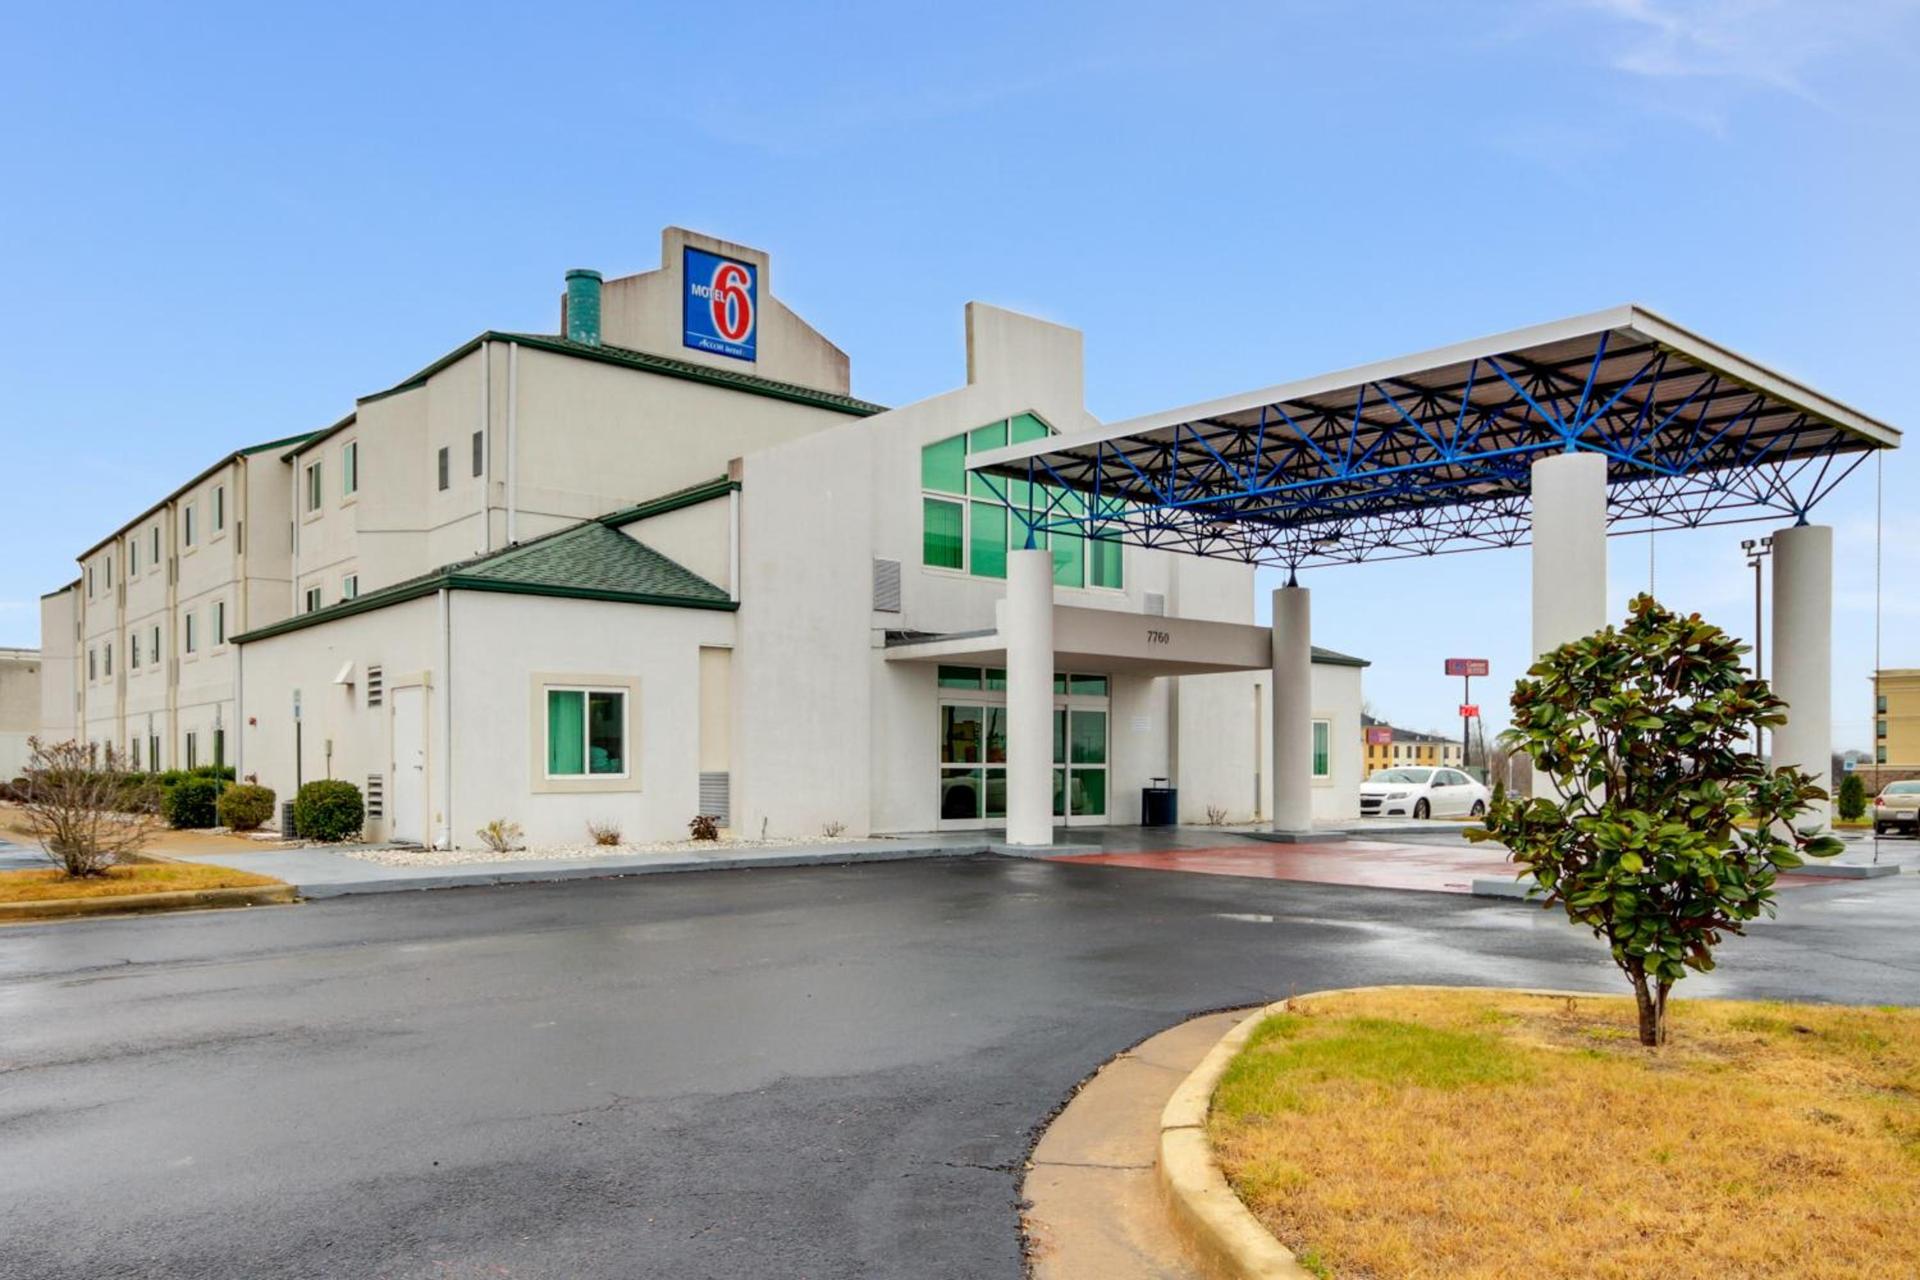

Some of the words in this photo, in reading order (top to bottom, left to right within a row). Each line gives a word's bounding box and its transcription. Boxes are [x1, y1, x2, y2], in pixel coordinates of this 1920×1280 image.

[691, 283, 726, 303] MOTEL
[710, 261, 753, 343] 6
[1147, 630, 1170, 645] 7760
